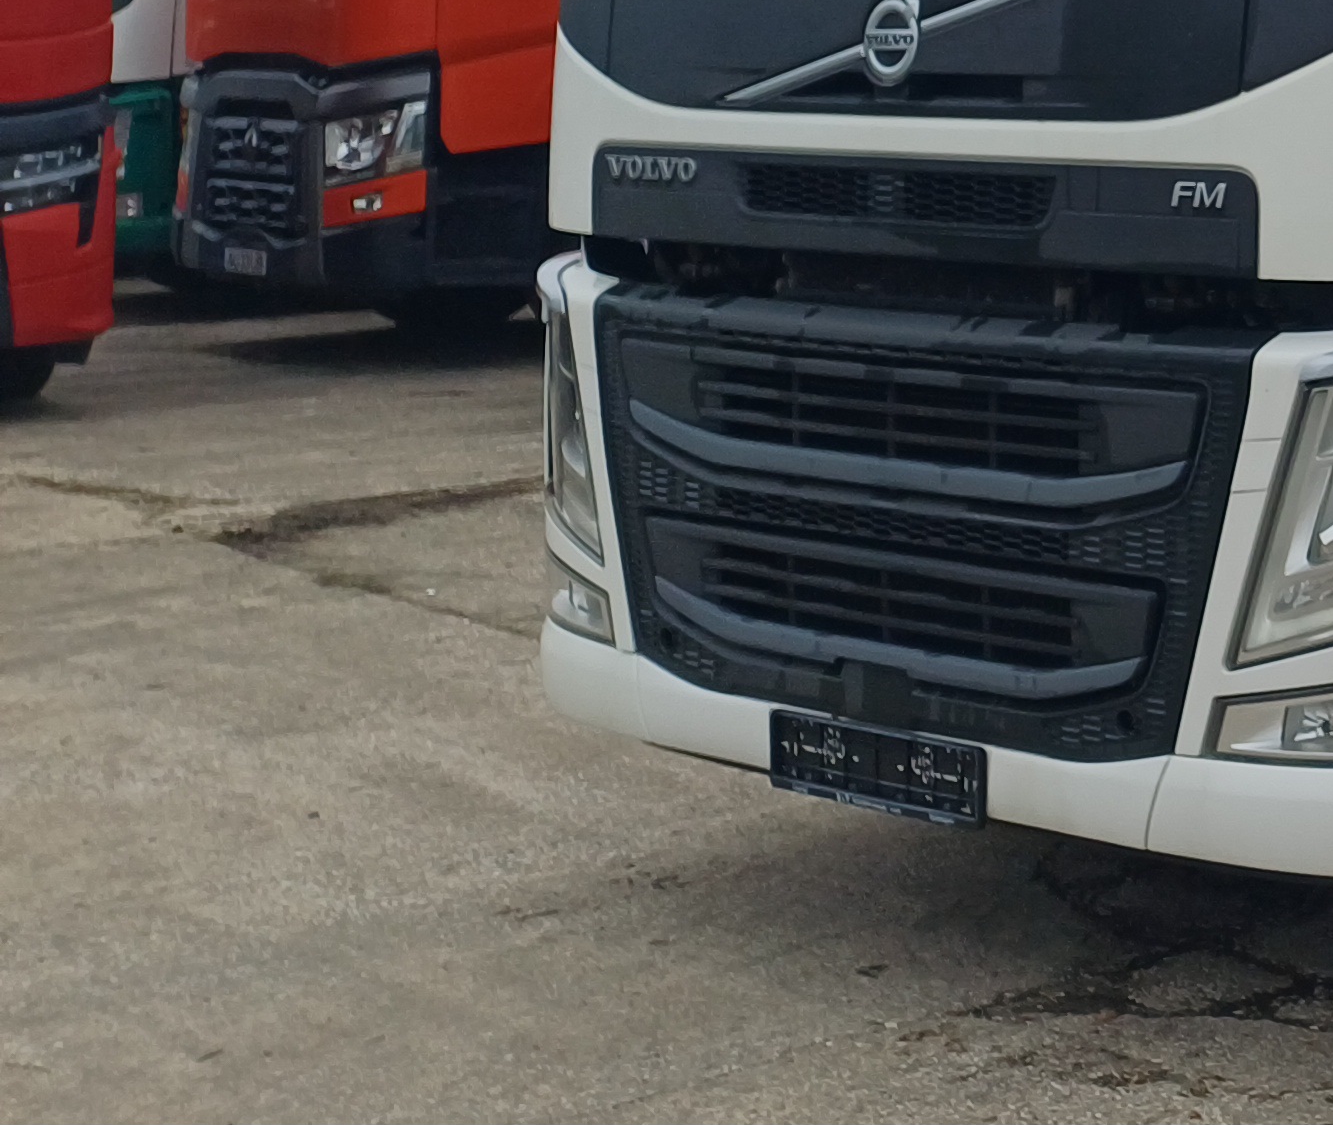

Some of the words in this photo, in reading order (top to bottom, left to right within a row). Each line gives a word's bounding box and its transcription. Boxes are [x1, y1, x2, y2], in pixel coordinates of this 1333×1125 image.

[865, 34, 914, 48] VOLVO
[604, 153, 697, 182] VOLVO
[1171, 181, 1227, 209] FM
